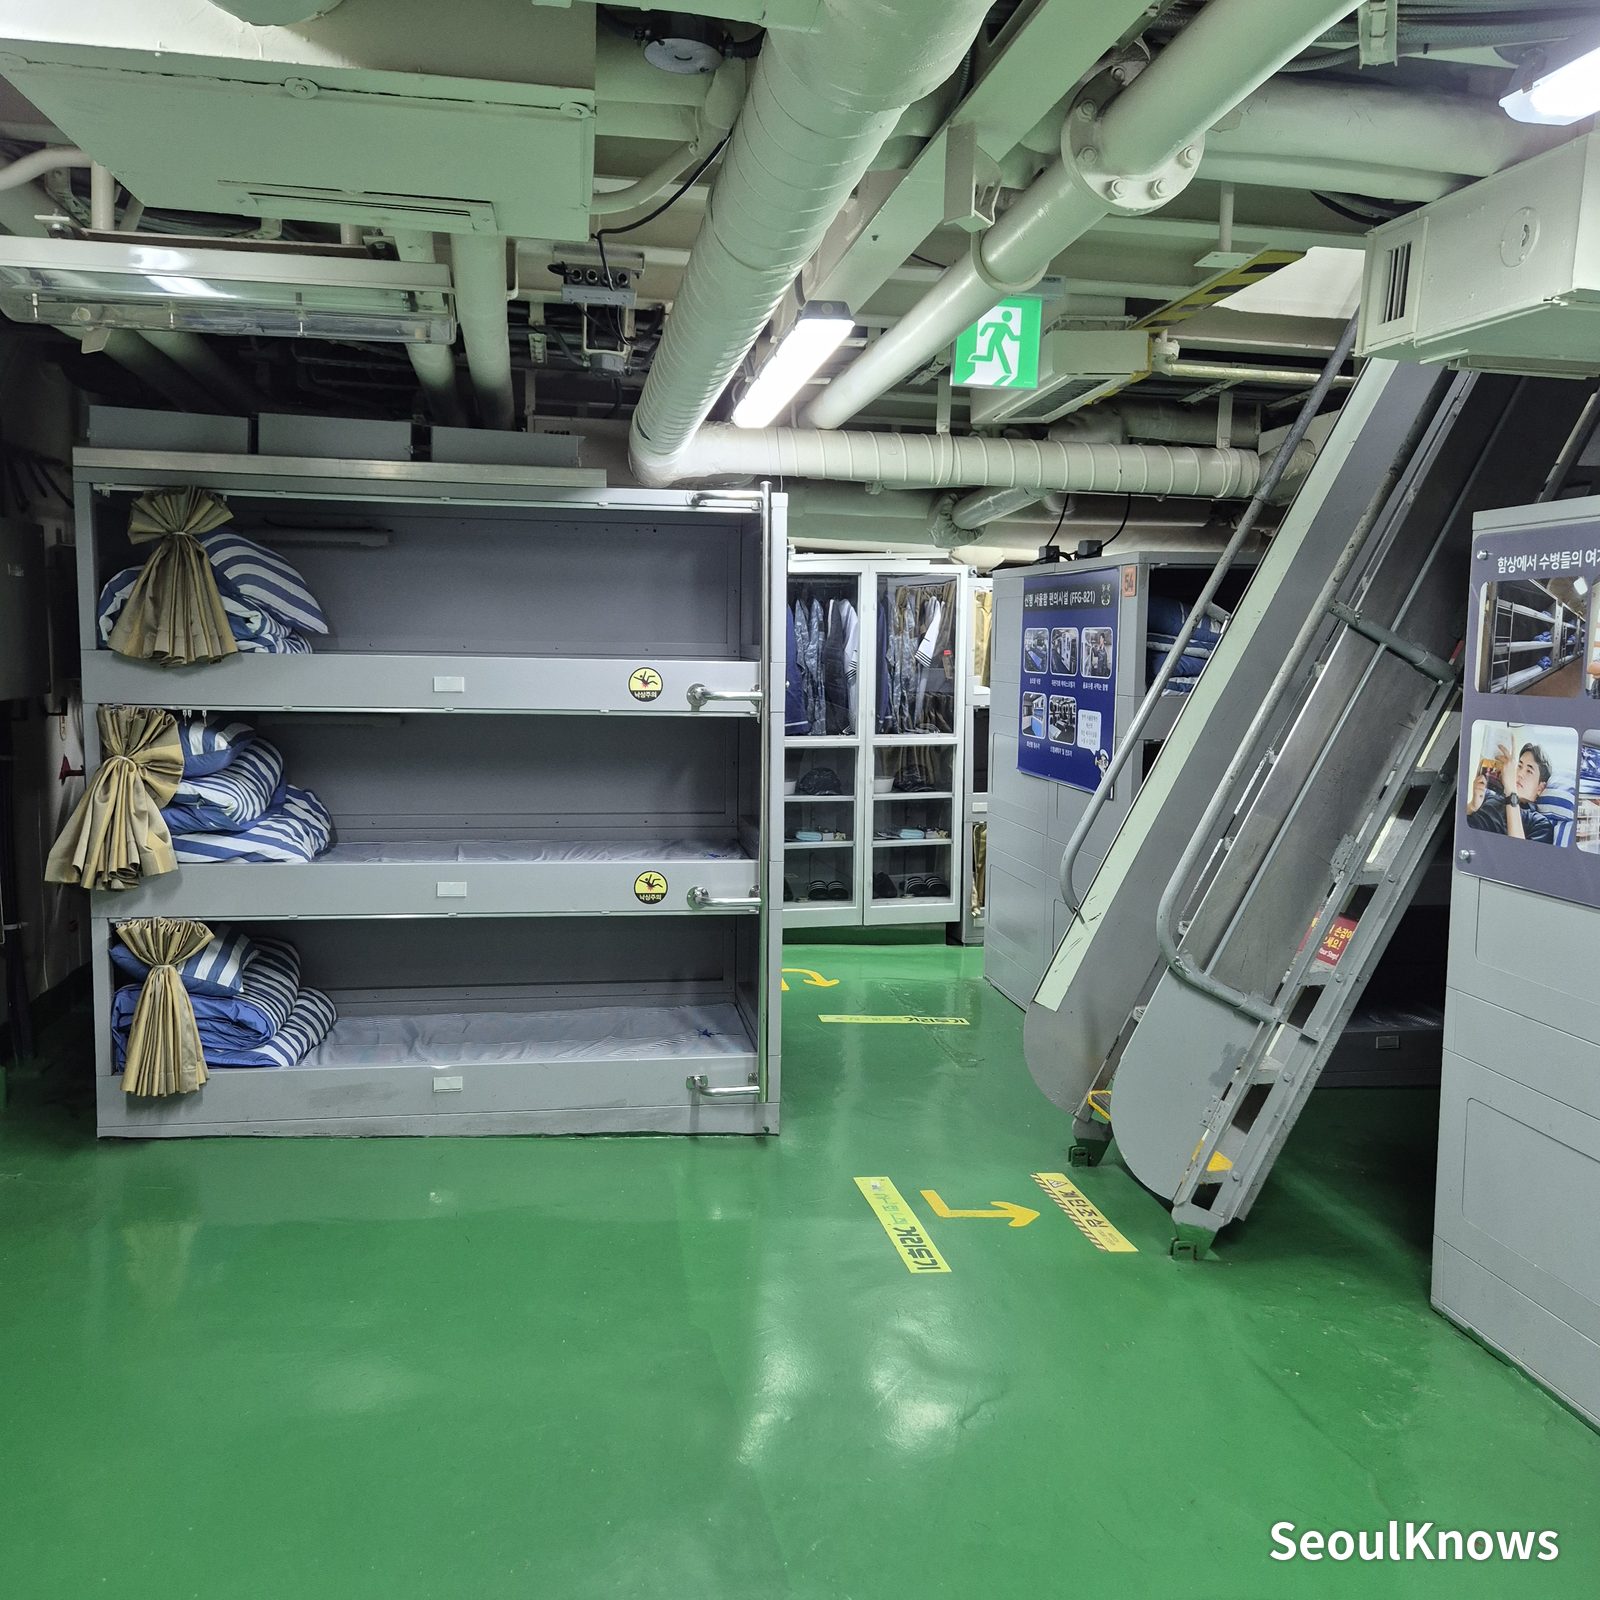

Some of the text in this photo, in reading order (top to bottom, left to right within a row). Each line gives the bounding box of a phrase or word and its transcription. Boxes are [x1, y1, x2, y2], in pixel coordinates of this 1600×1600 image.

[1498, 554, 1537, 574] 함상에서
[1538, 550, 1583, 570] 수병들의
[1034, 592, 1048, 607] 서울함
[1049, 591, 1069, 606] 편의시설
[1069, 590, 1096, 606] (FFG-821)
[640, 894, 662, 902] 낙상주의
[1058, 1190, 1109, 1228] 계단조심
[892, 1226, 941, 1270] 거리두기
